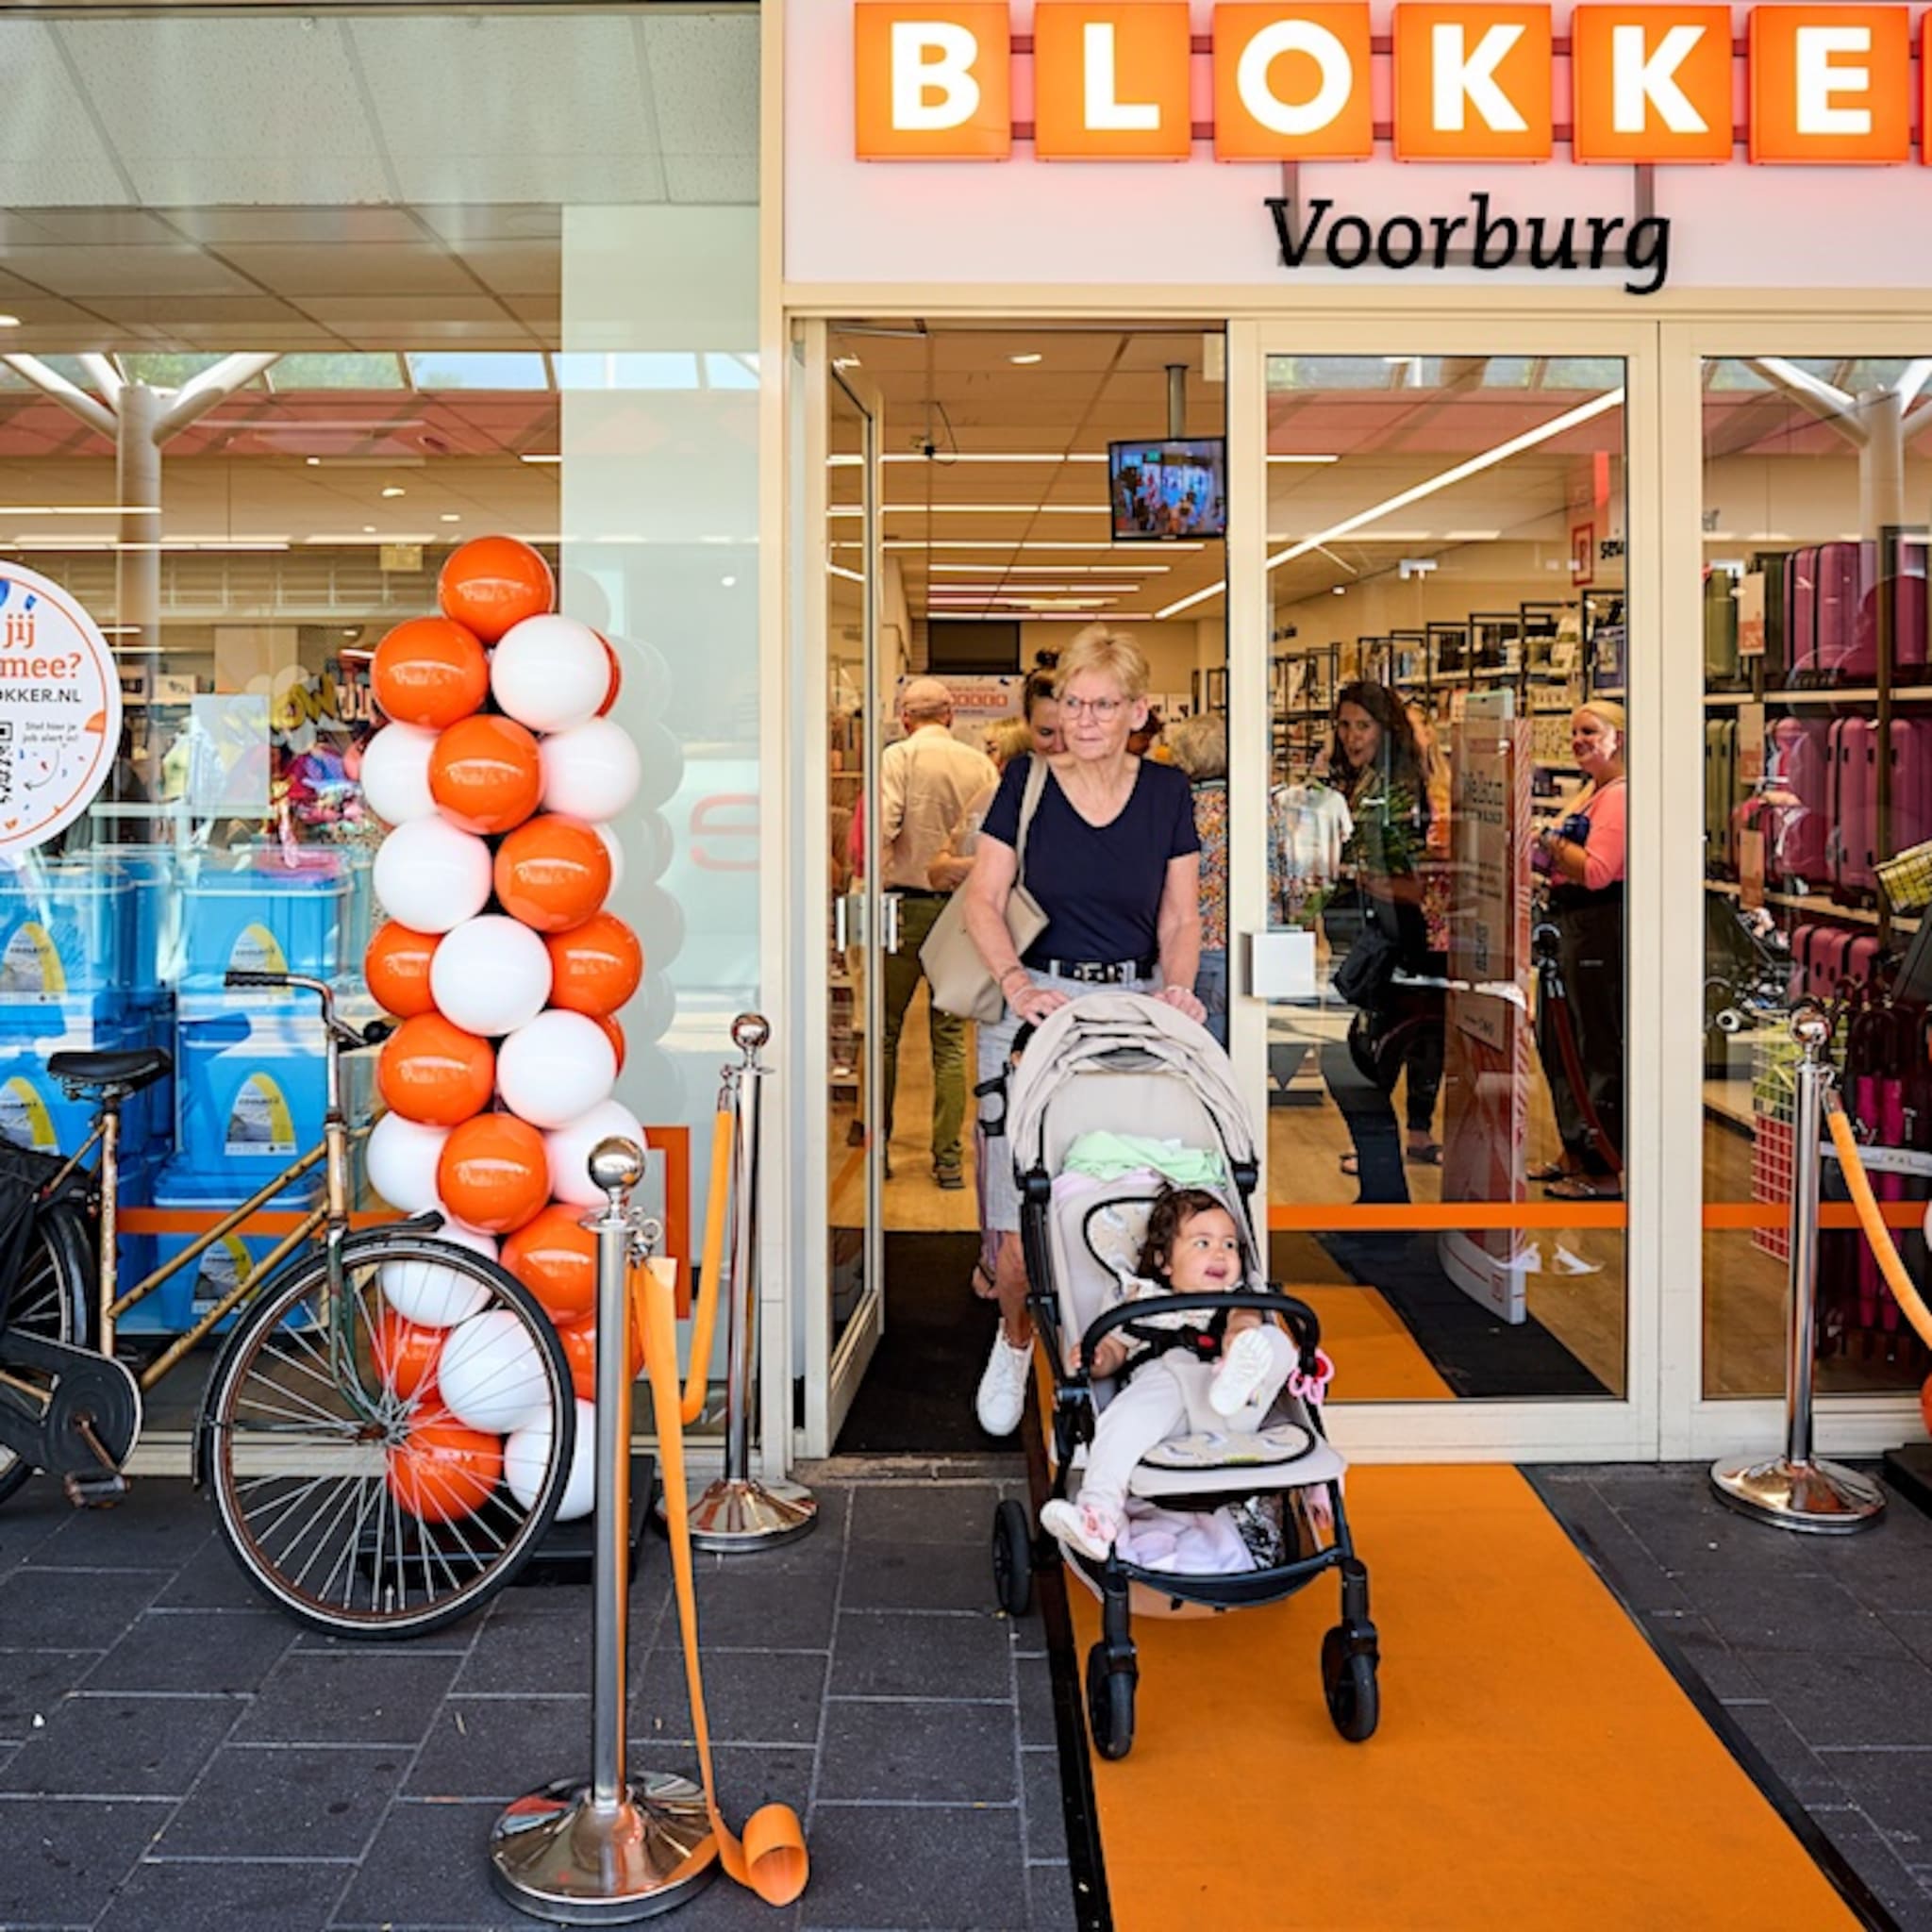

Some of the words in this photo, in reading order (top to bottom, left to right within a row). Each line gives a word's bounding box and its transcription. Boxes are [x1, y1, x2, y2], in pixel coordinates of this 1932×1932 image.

[1264, 192, 1671, 294] Voorburg
[3, 613, 35, 649] jij
[0, 652, 81, 678] mee?
[0, 689, 82, 703] KKER.NL
[46, 722, 65, 731] hier
[67, 723, 77, 733] je
